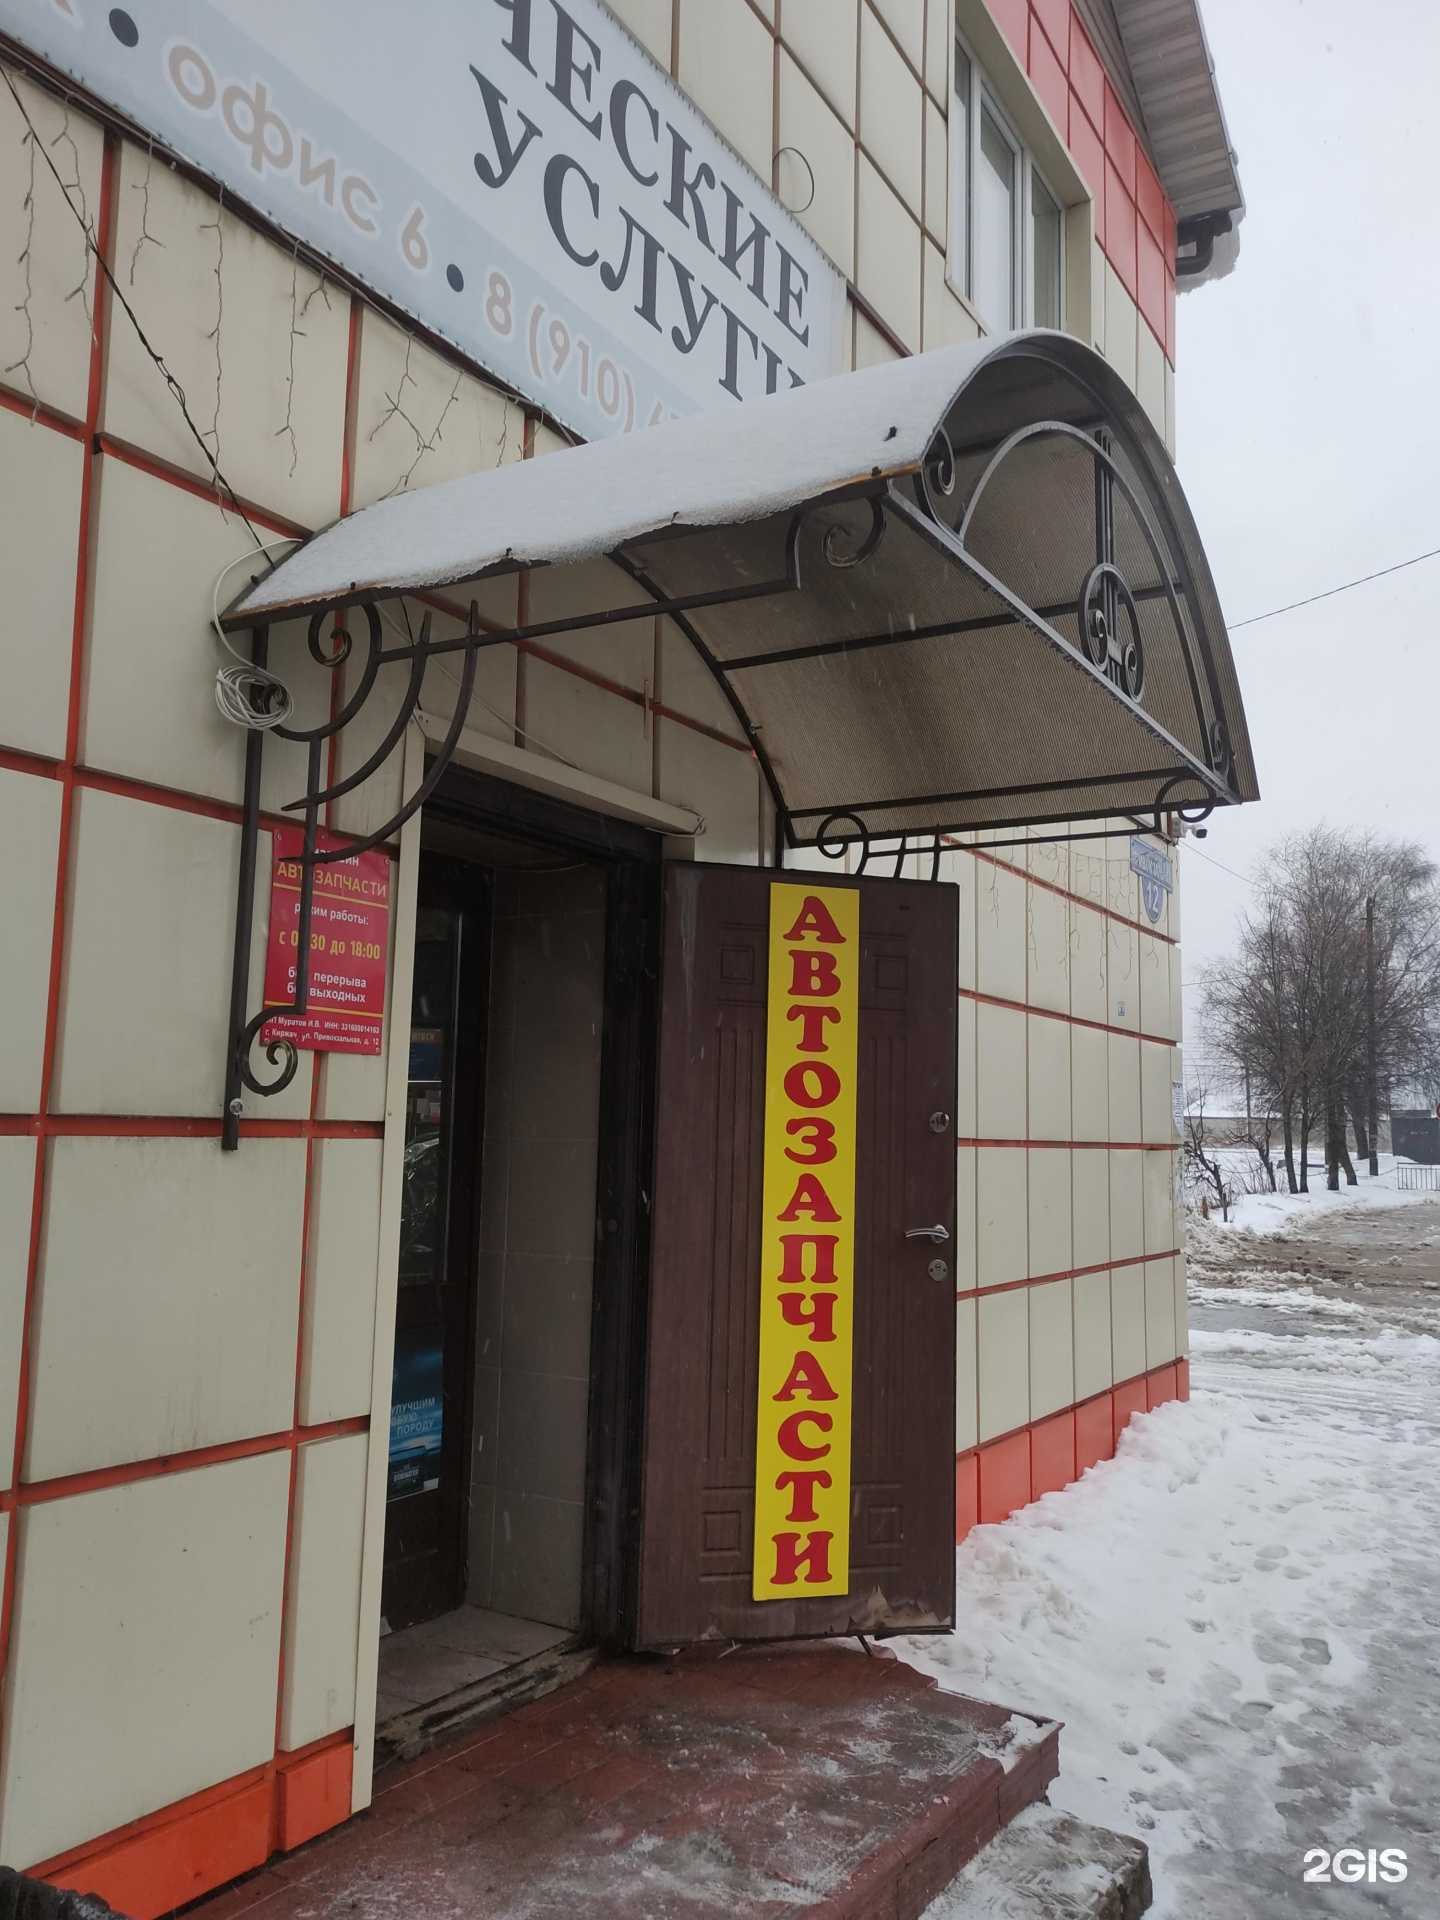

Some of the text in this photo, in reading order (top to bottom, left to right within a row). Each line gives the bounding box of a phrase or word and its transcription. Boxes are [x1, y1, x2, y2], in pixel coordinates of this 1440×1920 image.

[168, 45, 378, 233] офис
[402, 207, 428, 270] 6
[486, 272, 512, 335] 8
[277, 861, 388, 897] АВТЗАПЧАСТИ
[1147, 880, 1159, 914] 12
[330, 909, 369, 926] работы:
[329, 940, 346, 956] до
[349, 941, 381, 960] 18:00
[313, 972, 367, 989] перерыва
[309, 987, 366, 1003] выходных
[768, 895, 848, 1586] АВТОЗАПЧАСТИ
